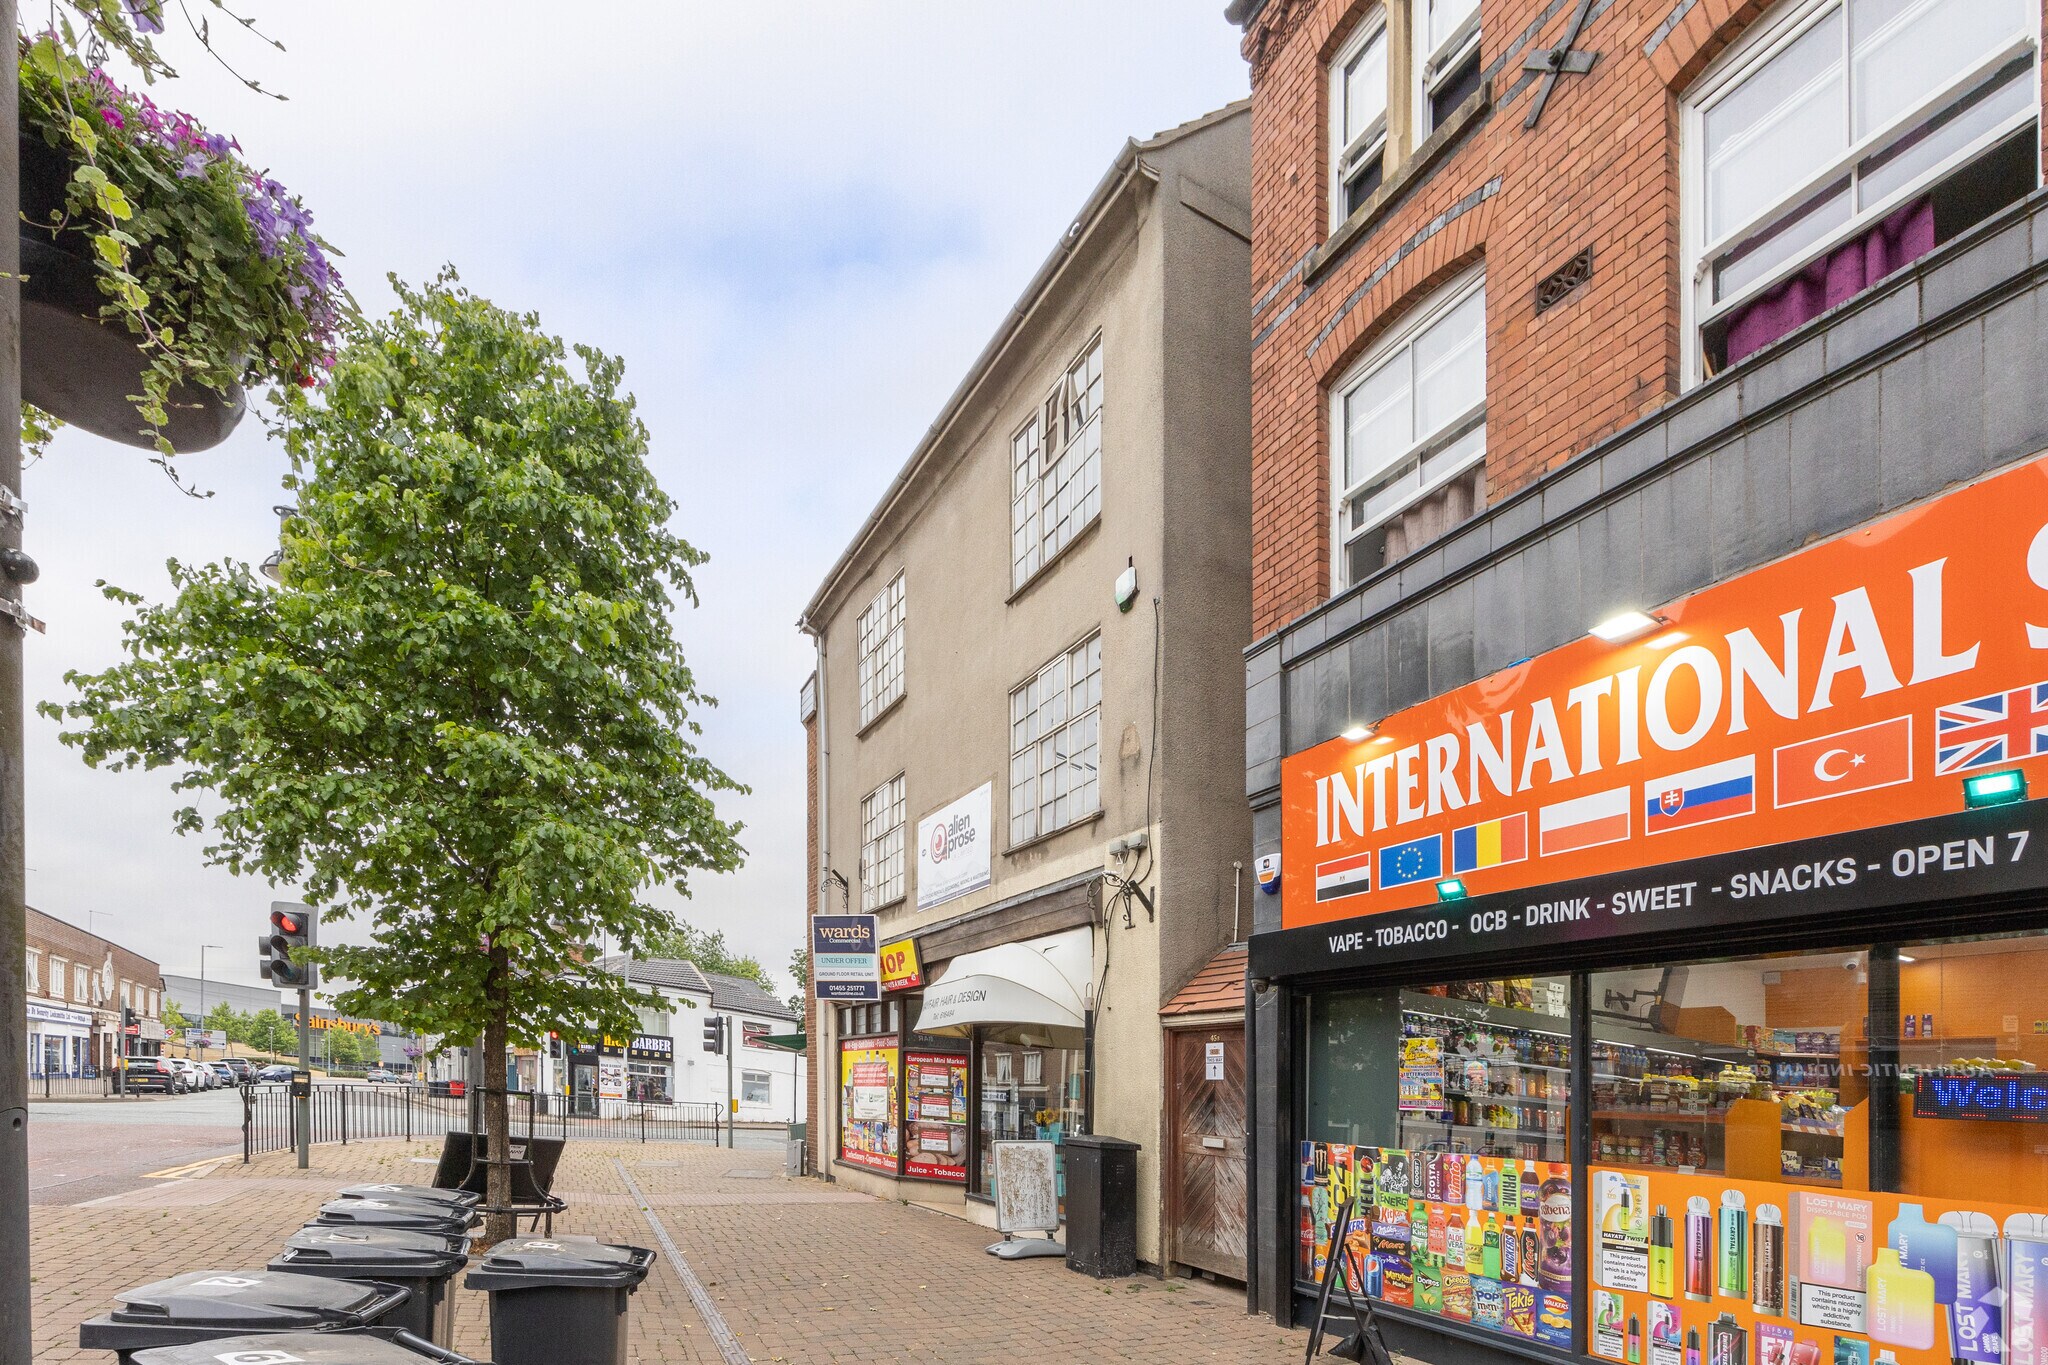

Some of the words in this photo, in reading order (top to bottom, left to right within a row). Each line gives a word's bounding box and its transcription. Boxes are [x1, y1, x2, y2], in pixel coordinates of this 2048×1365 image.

[1315, 557, 1982, 848] INTERNATIONAL
[948, 813, 970, 838] alien
[947, 827, 976, 860] prose
[1329, 932, 1364, 953] VAPE
[1375, 919, 1448, 948] TOBACCO
[1470, 913, 1508, 935] OCB
[1526, 897, 1591, 927] DRINK
[1611, 881, 1697, 916] SWEET
[1730, 857, 1857, 899] SNACKS
[1892, 835, 1995, 878] OPEN
[2007, 830, 2030, 862] 7
[819, 924, 871, 939] wards
[940, 994, 953, 1006] HAIR
[958, 990, 987, 1003] DESIGN
[632, 1037, 672, 1052] BARBER
[907, 1055, 933, 1063] European
[1931, 1078, 2048, 1111] Welc
[907, 1165, 928, 1174] Juice
[932, 1168, 966, 1178] Tobacco
[1428, 1163, 1436, 1194] COSTA
[1447, 1160, 1463, 1200] Vimto
[1360, 1178, 1374, 1216] HELL
[1502, 1173, 1517, 1208] PRIME
[1540, 1204, 1571, 1215] Ribena
[1806, 1197, 1835, 1208] LOST
[1836, 1202, 1868, 1213] MARY
[1806, 1206, 1850, 1218] DISPOSABLE
[1851, 1212, 1868, 1220] POD
[1412, 1222, 1428, 1230] Aloe
[1412, 1228, 1428, 1238] King
[1378, 1239, 1406, 1250] Mars
[1448, 1233, 1463, 1242] ALOE
[1627, 1235, 1644, 1243] TWIST
[1448, 1240, 1463, 1250] VERA
[1899, 1232, 1909, 1261] MARY
[1505, 1234, 1515, 1276] SNICKERS
[1523, 1236, 1536, 1279] Mars
[1621, 1254, 1641, 1263] product
[1604, 1259, 1625, 1267] contains
[1625, 1261, 1646, 1270] nicotine
[1604, 1266, 1620, 1274] which
[1629, 1268, 1646, 1277] highly
[1416, 1276, 1440, 1288] Doritos
[1444, 1276, 1470, 1287] Cheetos
[1612, 1281, 1638, 1290] substance
[1613, 1274, 1637, 1283] addictive
[2013, 1252, 2035, 1308] MARY
[1818, 1289, 1831, 1298] This
[1832, 1292, 1856, 1301] product
[1877, 1277, 1887, 1304] MARY
[1506, 1292, 1535, 1311] Takis
[1543, 1298, 1570, 1310] WALKERS
[1811, 1296, 1837, 1305] contains
[1838, 1299, 1862, 1309] nicotine
[1812, 1303, 1830, 1312] which
[1842, 1306, 1861, 1317] highly
[1823, 1311, 1850, 1321] addictive
[1820, 1318, 1853, 1329] substance.
[1877, 1305, 1887, 1331] LOST
[1957, 1302, 1978, 1352] LOST
[1991, 1332, 1999, 1355] GRAPE
[2013, 1308, 2035, 1365] LOST
